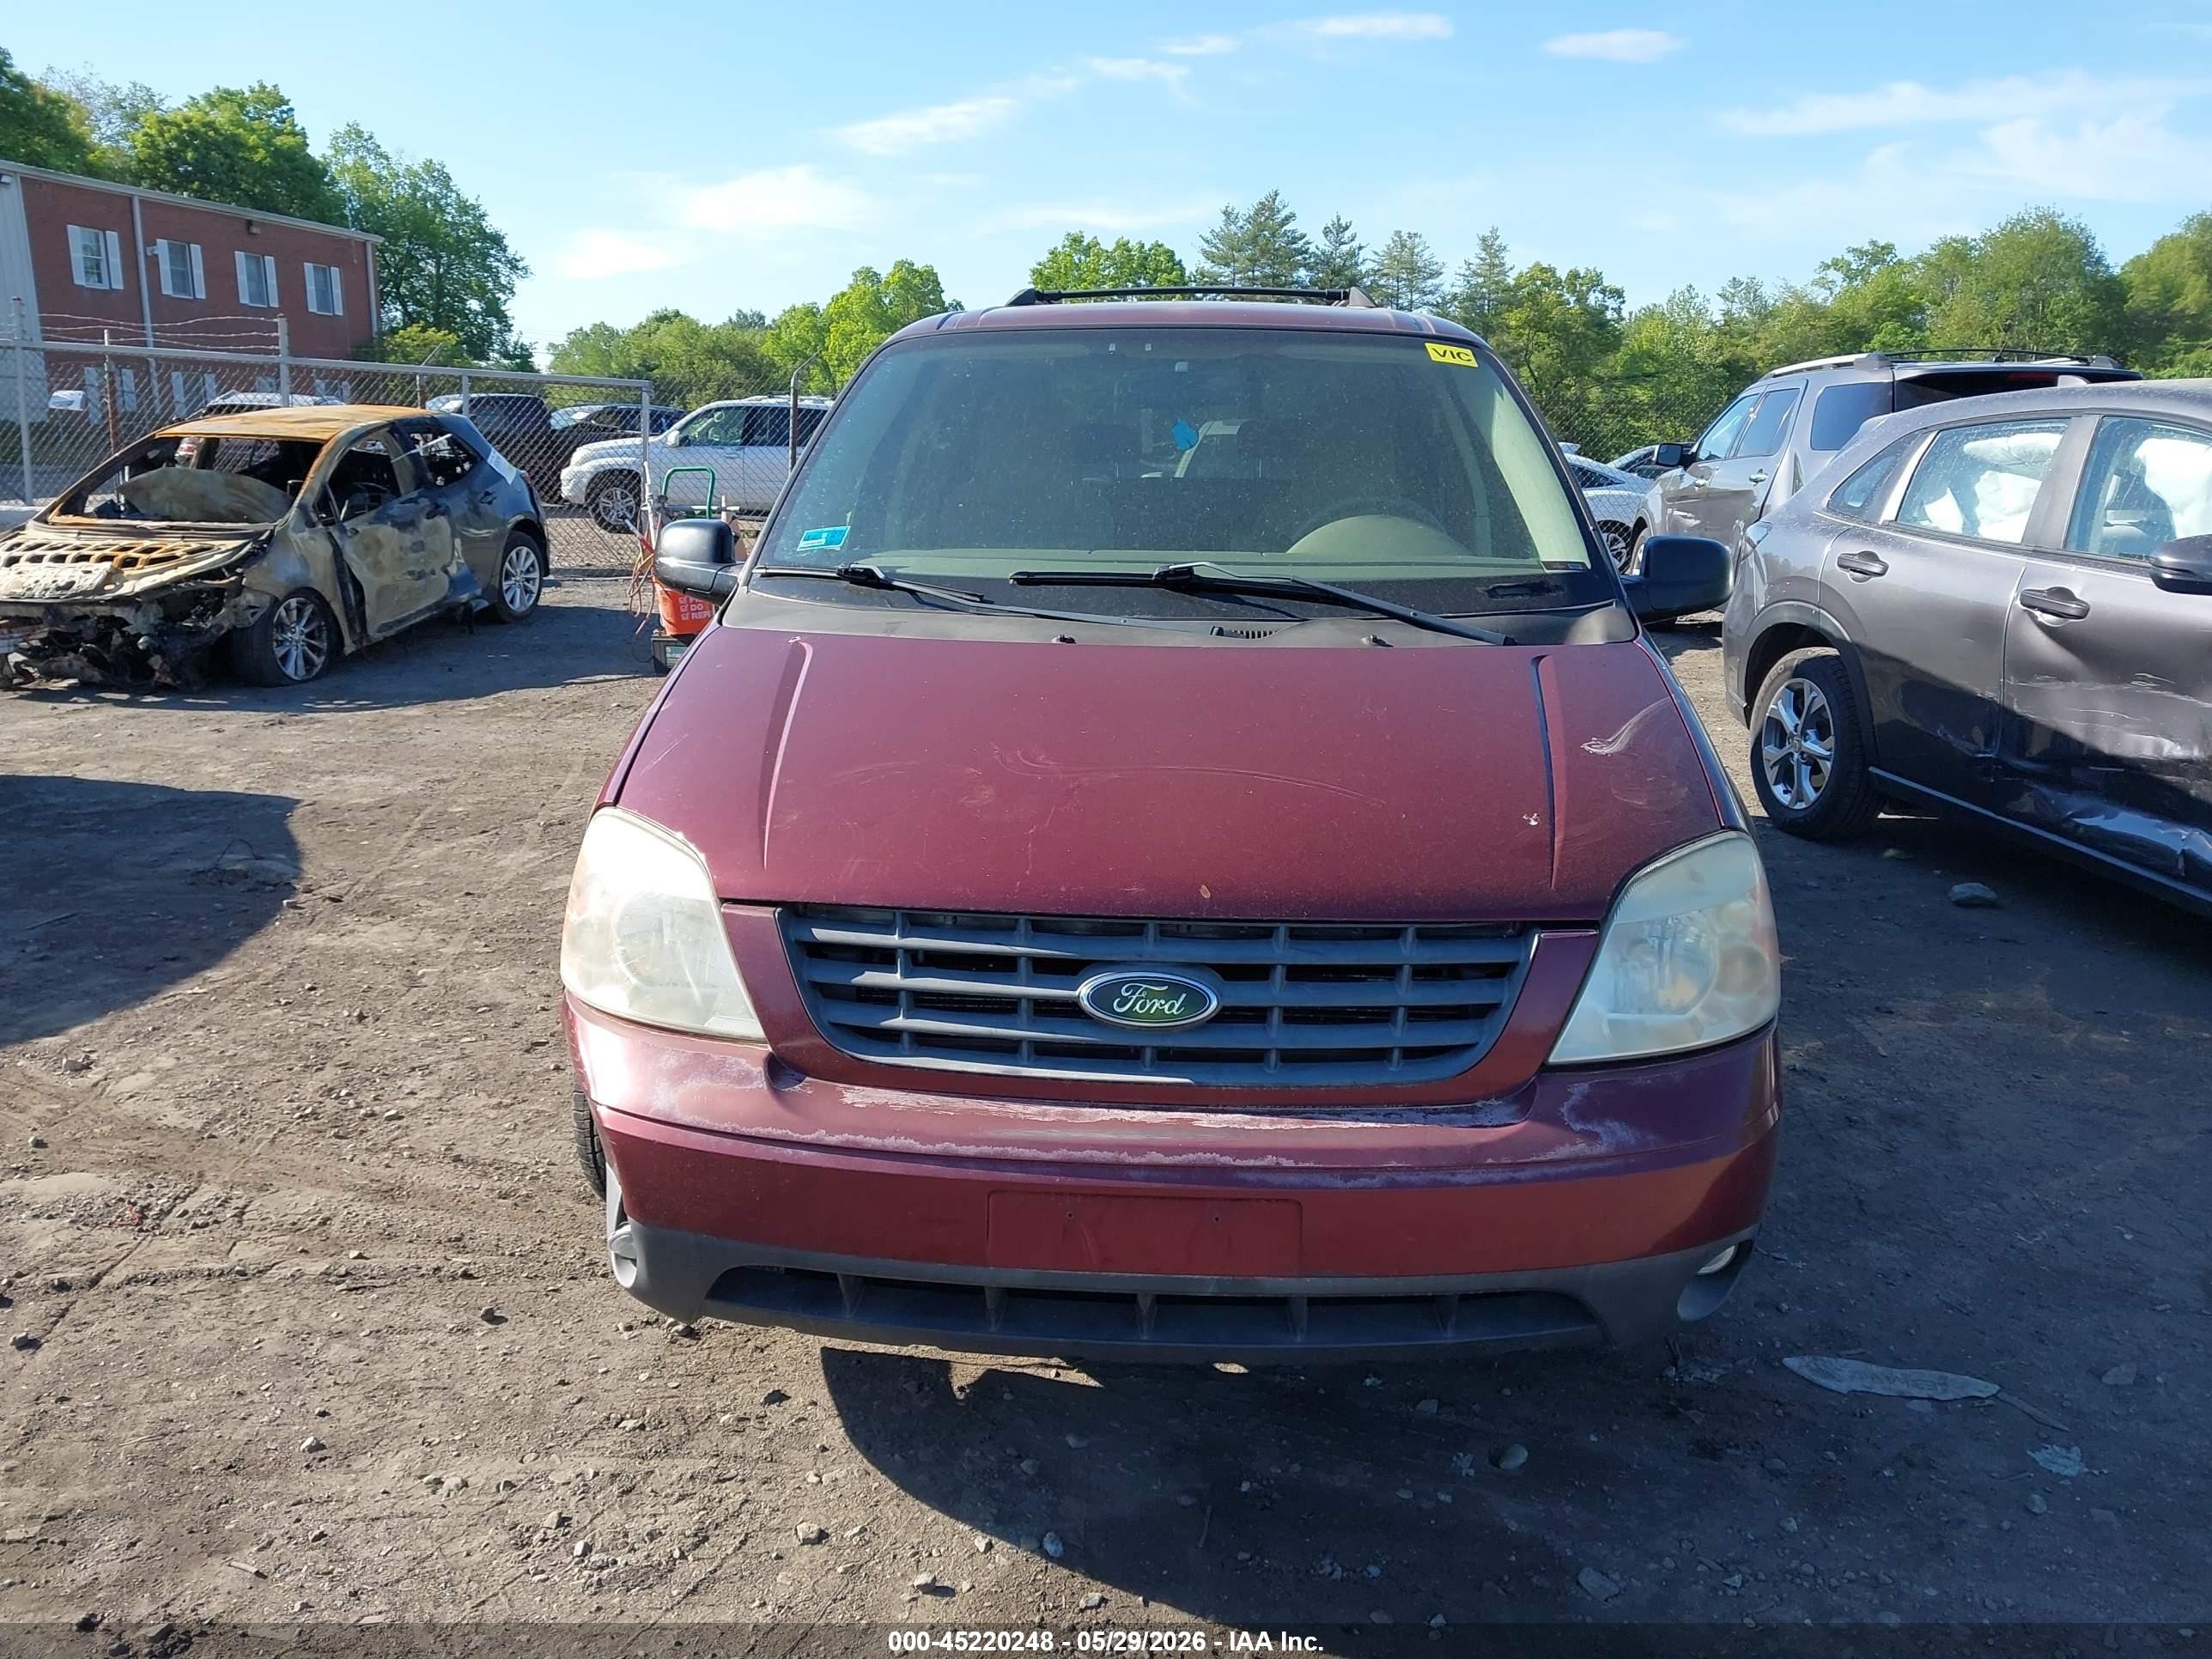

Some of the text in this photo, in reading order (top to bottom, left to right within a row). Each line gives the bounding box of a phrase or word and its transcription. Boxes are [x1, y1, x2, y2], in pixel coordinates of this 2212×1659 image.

[1431, 347, 1472, 362] VIC
[690, 603, 704, 611] DO
[1112, 982, 1187, 1016] Ford
